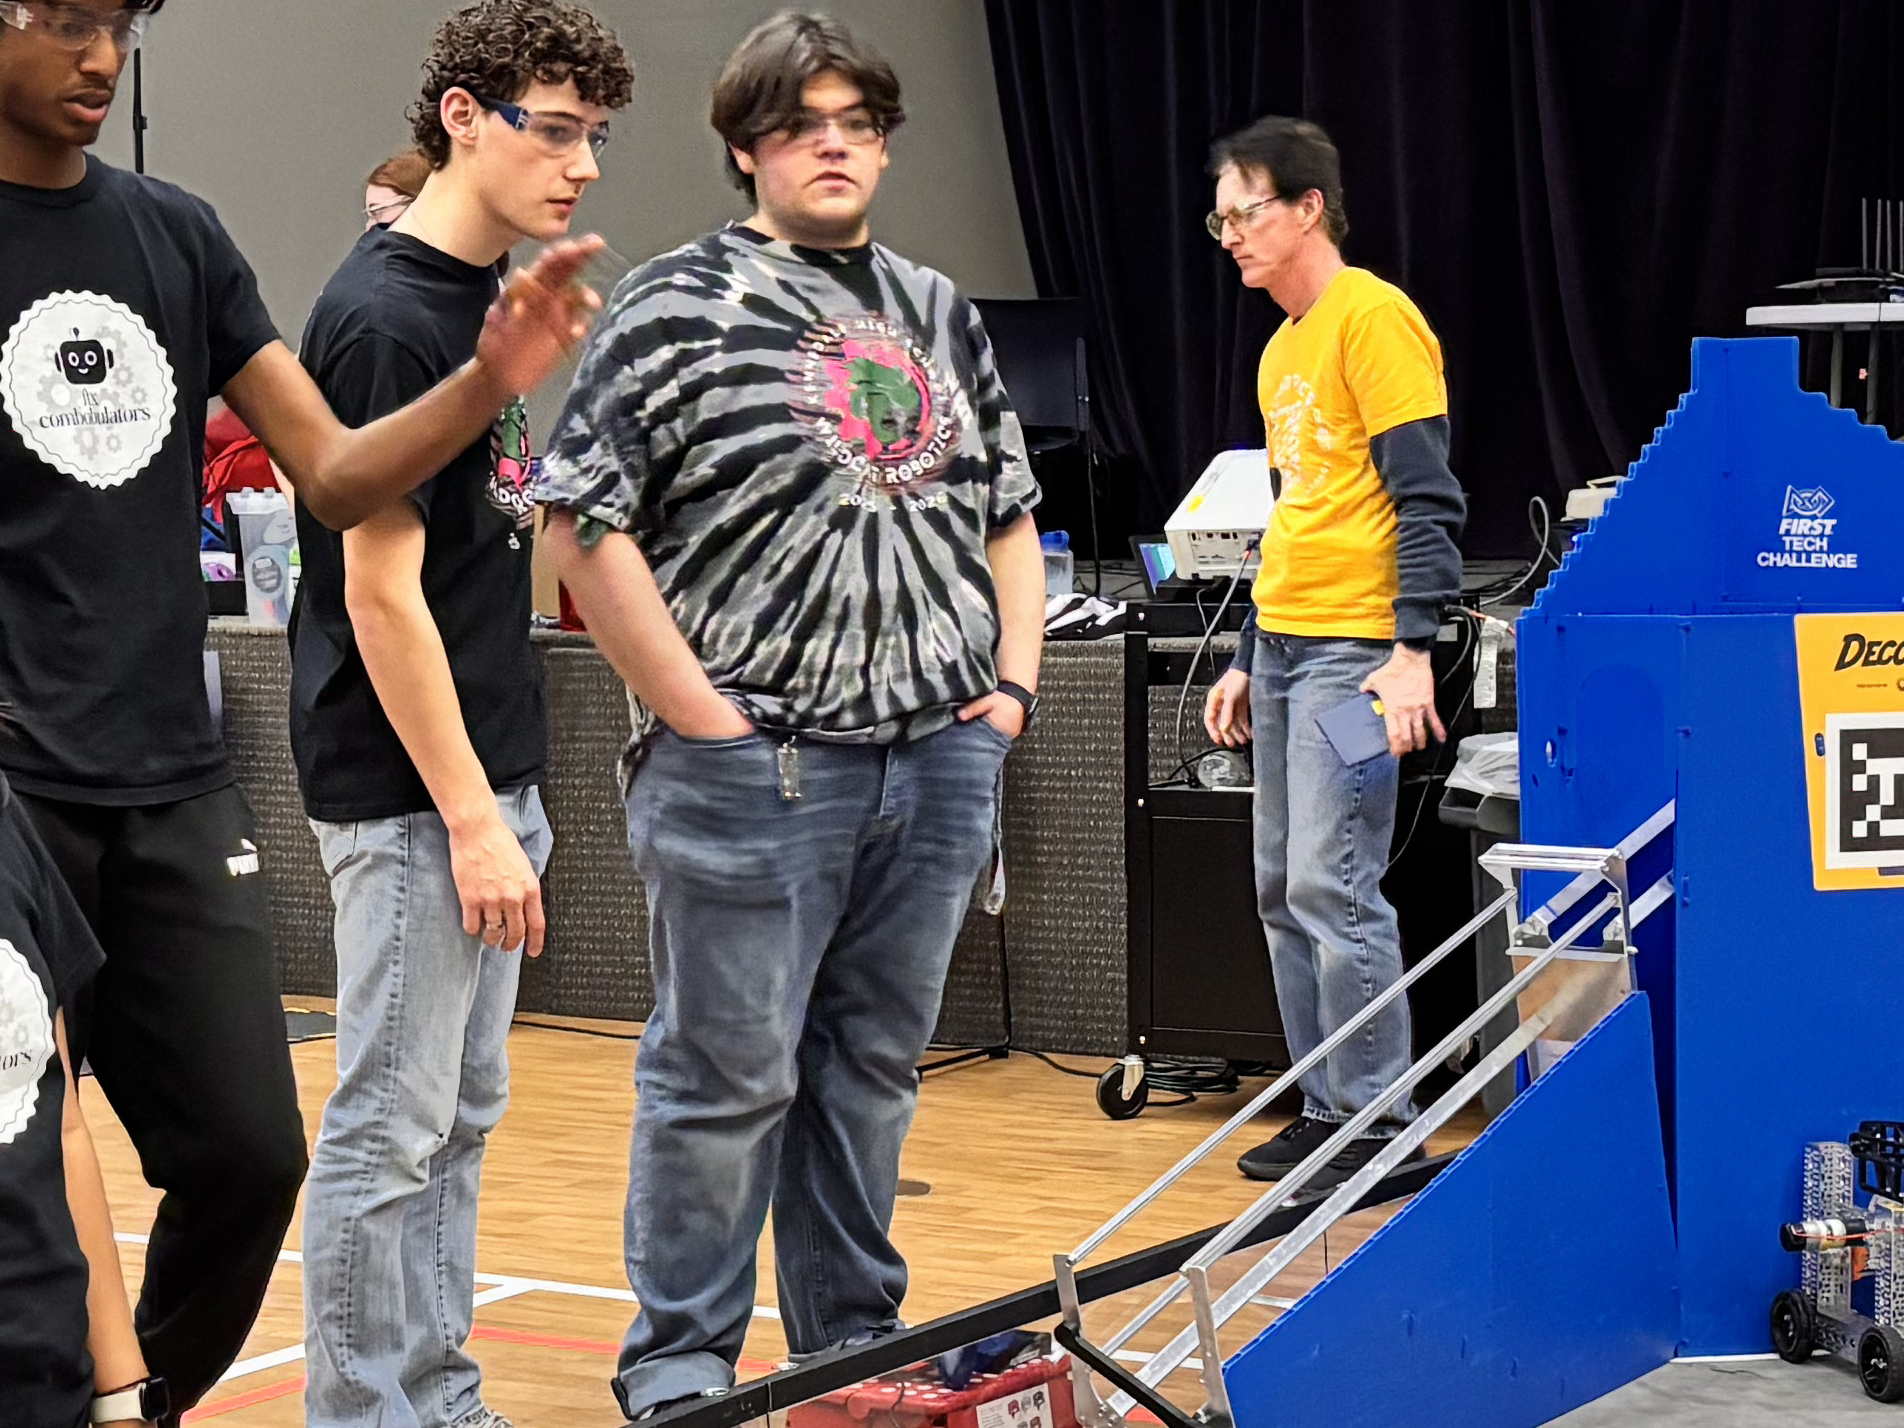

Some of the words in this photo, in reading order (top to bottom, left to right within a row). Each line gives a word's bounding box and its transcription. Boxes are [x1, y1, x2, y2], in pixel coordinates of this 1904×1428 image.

[1779, 519, 1837, 535] FIRST
[1782, 537, 1828, 551] TECH
[1757, 552, 1858, 568] CHALLENGE
